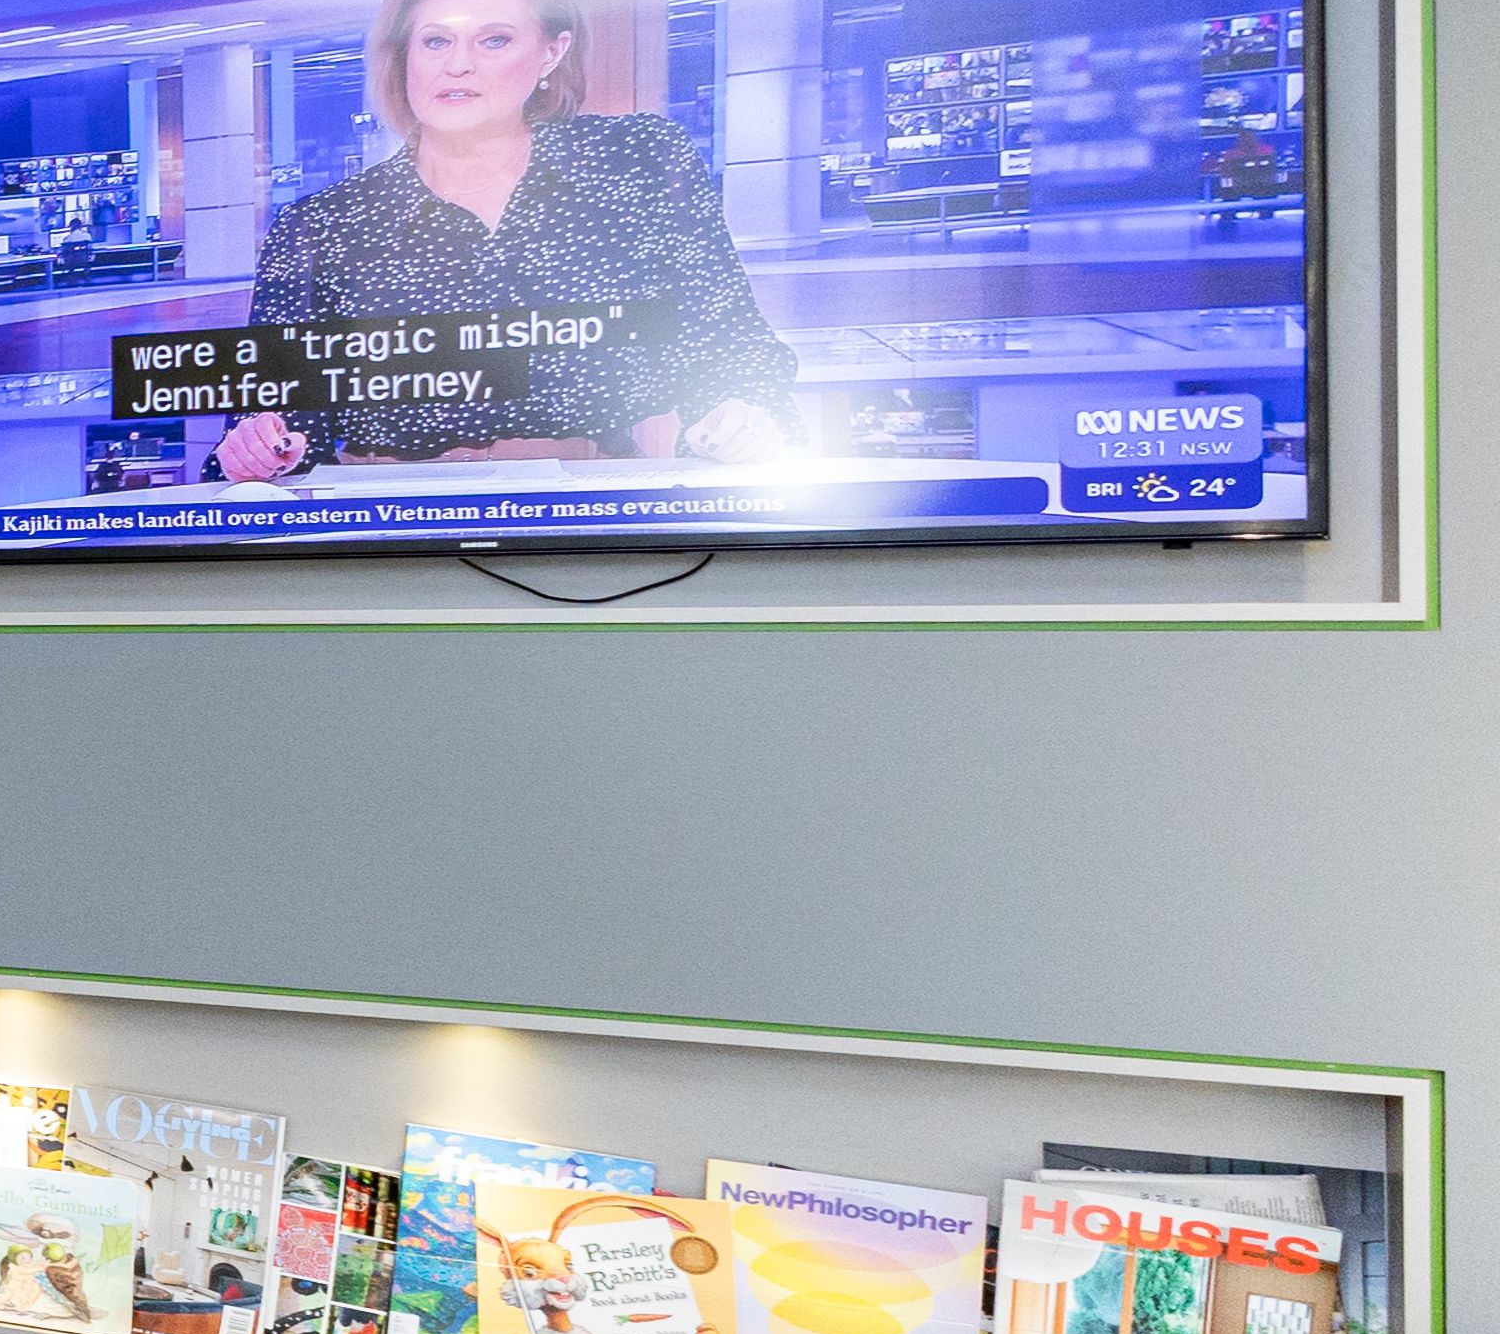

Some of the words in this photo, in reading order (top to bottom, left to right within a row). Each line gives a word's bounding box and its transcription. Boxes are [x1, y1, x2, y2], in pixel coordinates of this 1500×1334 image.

[131, 341, 215, 371] were
[236, 338, 258, 365] a
[284, 322, 436, 363] "tragic
[459, 307, 638, 353] mishap".
[132, 372, 299, 414] Jennifer
[322, 367, 493, 403] Tierney,
[1129, 405, 1245, 433] NEWS
[1098, 439, 1166, 458] 12:31
[1180, 441, 1233, 456] NSW
[1086, 482, 1123, 497] BRI
[1189, 477, 1237, 497] 24°
[3, 514, 63, 536] Kajiki
[66, 512, 134, 532] makes
[137, 509, 225, 529] landfall
[227, 512, 279, 527] over
[282, 508, 371, 526] eastern
[375, 503, 480, 523] Vietnam
[485, 499, 546, 520] after
[551, 501, 618, 518] mass
[621, 495, 787, 516] evacuations
[74, 1086, 277, 1166] VOGUE
[206, 1165, 264, 1187] WOMEN
[720, 1180, 973, 1235] NewPhilosopher
[1020, 1193, 1322, 1276] HOUSES
[580, 1242, 665, 1264] Parsley
[583, 1264, 678, 1293] Rabbit's
